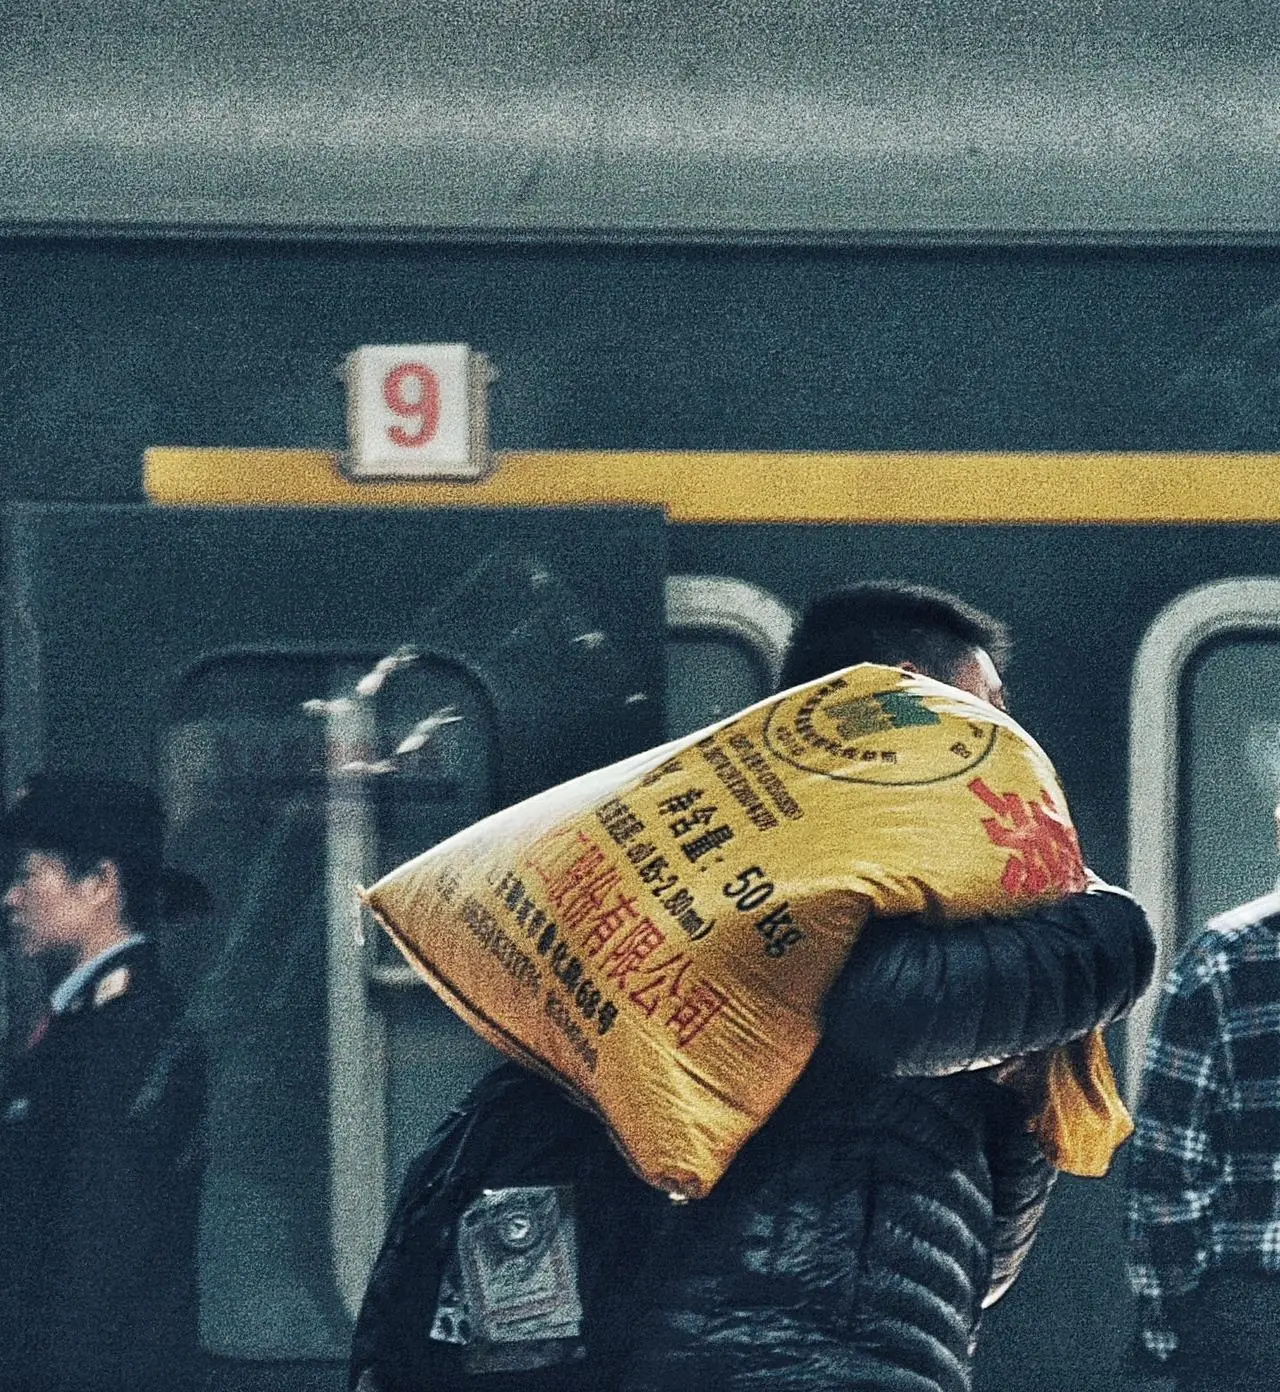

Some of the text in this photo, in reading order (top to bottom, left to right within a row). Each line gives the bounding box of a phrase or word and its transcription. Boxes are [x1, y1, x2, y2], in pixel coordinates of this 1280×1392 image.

[382, 362, 441, 448] 9
[722, 865, 774, 913] 50
[756, 900, 808, 955] kg
